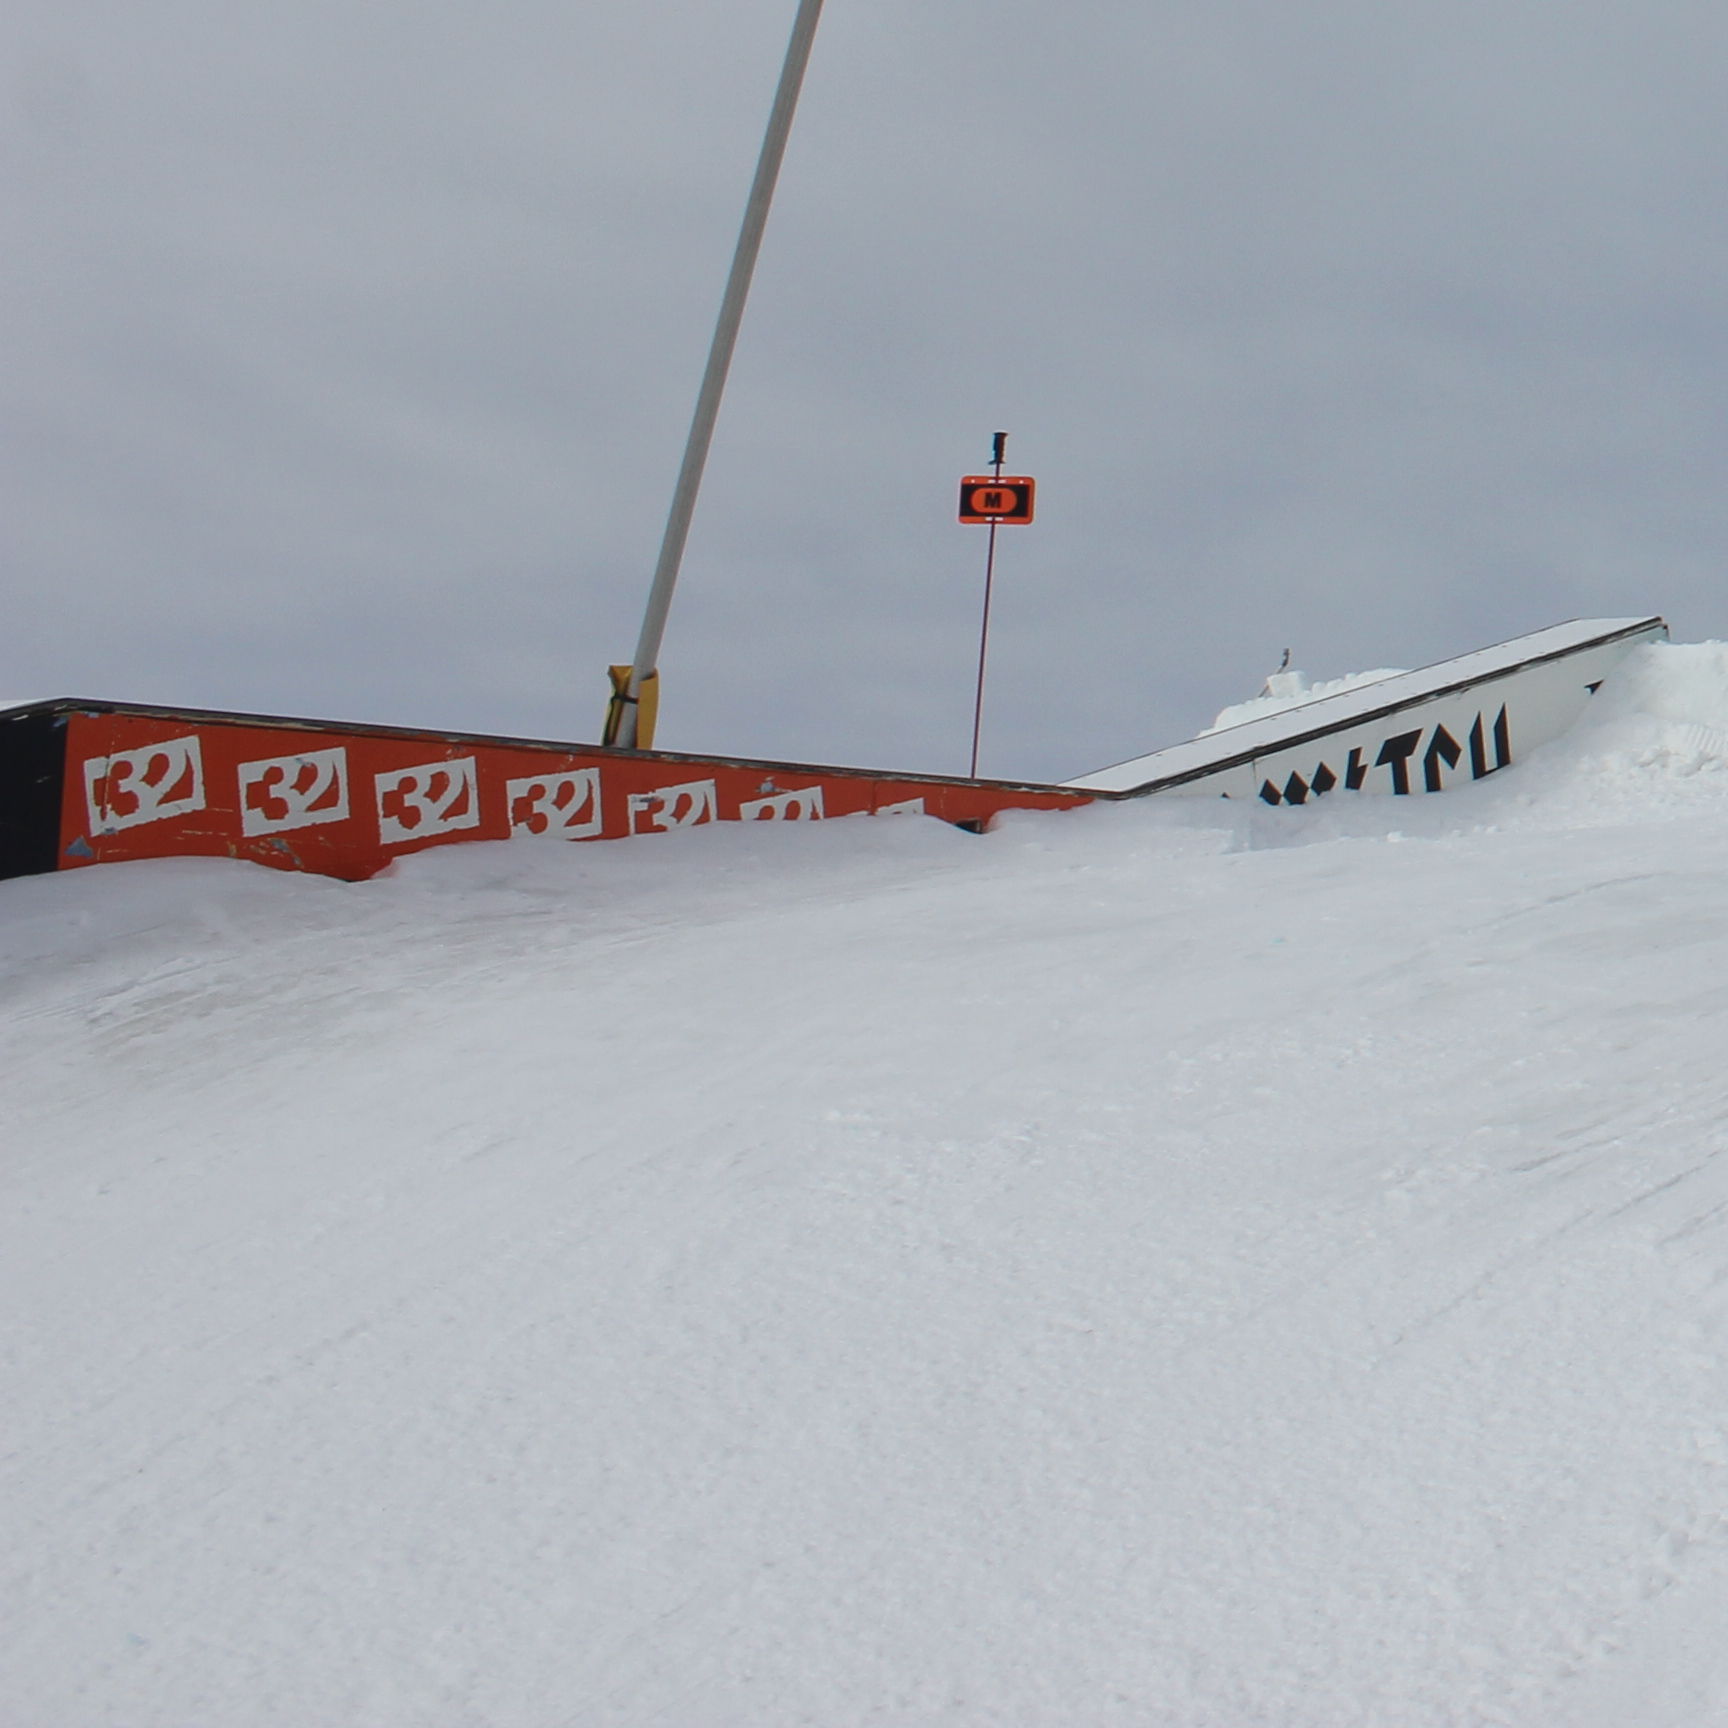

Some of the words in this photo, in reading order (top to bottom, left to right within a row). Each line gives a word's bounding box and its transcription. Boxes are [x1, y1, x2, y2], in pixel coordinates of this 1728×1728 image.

[84, 735, 206, 837] 32
[237, 746, 350, 838] 32
[374, 756, 480, 845] 32
[506, 767, 603, 838] 32
